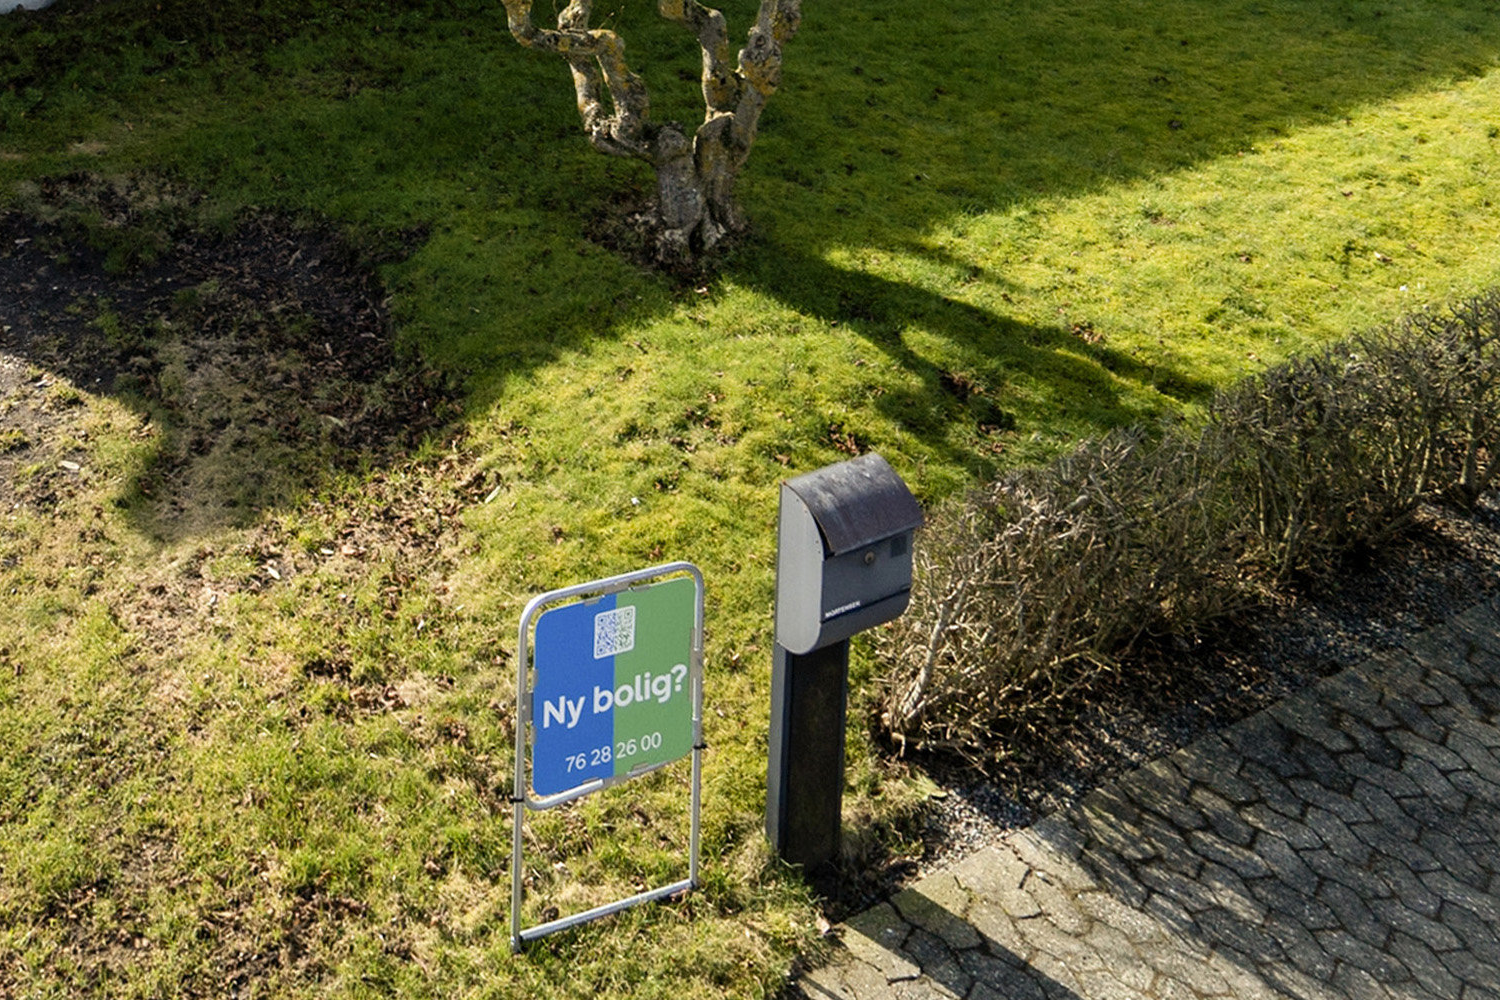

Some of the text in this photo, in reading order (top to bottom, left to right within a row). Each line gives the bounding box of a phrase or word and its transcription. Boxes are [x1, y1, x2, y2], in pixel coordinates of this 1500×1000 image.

[543, 664, 688, 729] Ny bolig?
[565, 732, 662, 773] 76 28 26 00
